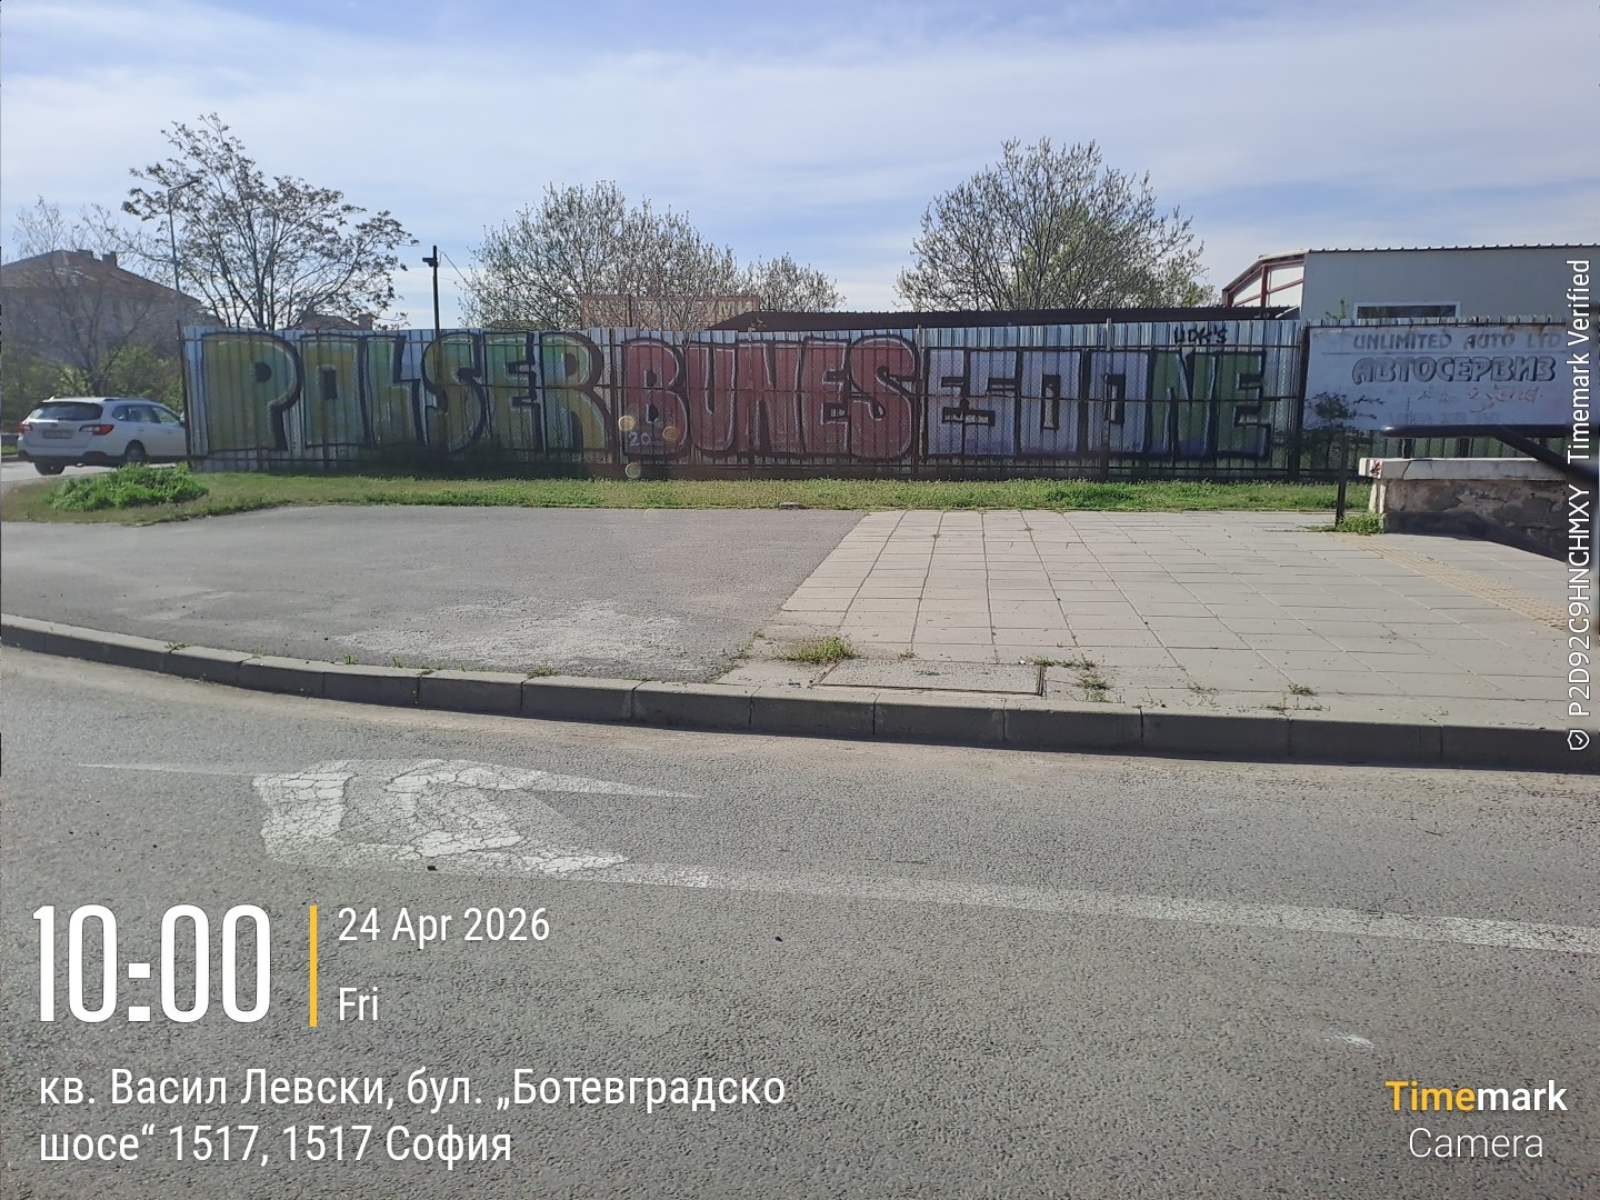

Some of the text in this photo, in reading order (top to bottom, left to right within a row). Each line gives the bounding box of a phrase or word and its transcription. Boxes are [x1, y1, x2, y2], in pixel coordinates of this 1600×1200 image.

[1352, 333, 1562, 350] UNLIMITED AUTO LTD
[1351, 355, 1557, 385] АВТОСЕРВИЗ
